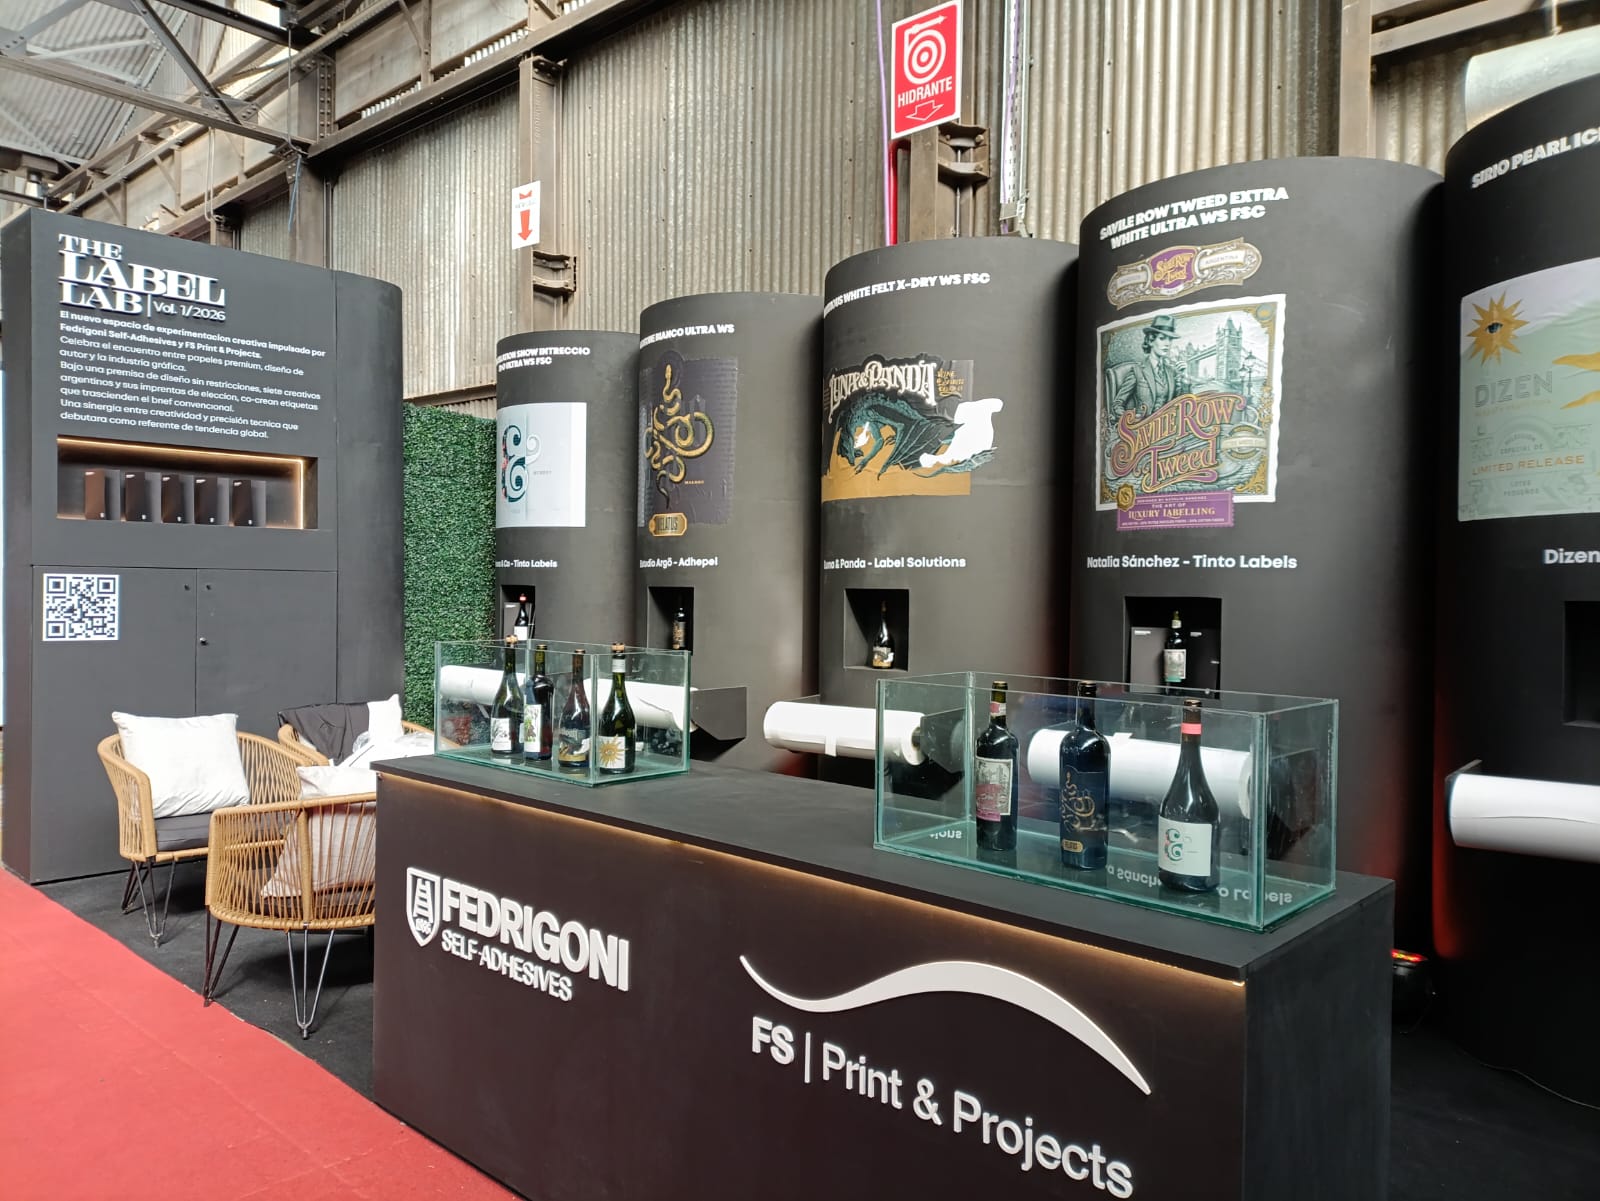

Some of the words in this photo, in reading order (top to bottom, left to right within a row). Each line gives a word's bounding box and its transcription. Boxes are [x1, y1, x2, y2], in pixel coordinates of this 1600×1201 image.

[897, 75, 952, 108] HIDRANTE
[1471, 159, 1510, 188] SIRIO
[1511, 136, 1572, 171] PEARL
[1573, 126, 1600, 149] IC
[1100, 215, 1134, 240] SAVILE
[1135, 204, 1170, 226] ROW
[1169, 194, 1227, 215] TWEED
[1229, 187, 1289, 204] EXTRA
[1110, 225, 1150, 249] WHITE
[1150, 214, 1200, 237] ULTRA
[1200, 208, 1229, 225] WS
[1230, 205, 1266, 221] FSC
[58, 233, 123, 260] THE
[58, 250, 226, 306] LABEL
[843, 285, 871, 303] WHITE
[871, 280, 896, 295] FELT
[896, 276, 938, 290] X-DRY
[939, 274, 961, 286] WS
[963, 272, 991, 284] FSC
[58, 281, 143, 314] LAB
[153, 301, 178, 314] Vol.
[180, 304, 226, 321] 1/2026
[60, 310, 69, 318] El
[70, 313, 101, 324] nuevo
[103, 318, 141, 329] espacio
[142, 323, 155, 332] de
[232, 337, 267, 348] creativa
[268, 341, 310, 355] impulsado
[311, 349, 326, 357] por
[60, 323, 107, 336] Fedrigoni
[108, 330, 177, 346] Self-Adhesives
[177, 341, 184, 349] y
[185, 341, 196, 349] FS
[197, 342, 217, 353] Print
[219, 346, 225, 354] &
[226, 347, 262, 359] Projects.
[685, 324, 716, 335] ULTRA
[716, 323, 735, 333] WS
[59, 335, 100, 348] Celebra
[102, 342, 111, 350] el
[112, 344, 161, 357] encuentro
[162, 350, 186, 360] entre
[187, 354, 223, 365] papeles
[224, 359, 263, 371] premium,
[264, 363, 291, 374] diseño
[293, 367, 304, 376] de
[59, 349, 89, 358] autor
[89, 352, 96, 361] y
[97, 352, 106, 361] la
[108, 354, 150, 367] industria
[151, 361, 187, 372] gráfica.
[523, 357, 535, 366] WS
[536, 356, 552, 366] FSC
[60, 360, 83, 372] Bajo
[85, 365, 104, 374] una
[106, 367, 145, 378] premisa
[146, 371, 159, 380] de
[160, 373, 190, 385] diseño
[192, 377, 205, 386] sin
[205, 379, 262, 393] restricciones,
[262, 386, 282, 395] siete
[284, 389, 321, 400] creativos
[60, 374, 114, 387] argentinos
[114, 381, 121, 389] y
[122, 382, 139, 390] sus
[140, 382, 186, 395] imprentas
[187, 388, 199, 397] de
[240, 395, 279, 406] co-crean
[280, 400, 318, 411] etiquetas
[1474, 371, 1553, 408] DIZEN
[60, 387, 80, 396] que
[81, 389, 140, 402] trascienden
[141, 395, 150, 403] el
[174, 400, 235, 413] convencional.
[60, 398, 81, 408] Una
[82, 401, 122, 413] sinergia
[123, 406, 148, 415] entre
[149, 408, 202, 420] creatividad
[202, 414, 210, 422] y
[209, 414, 249, 425] precisión
[282, 422, 299, 431] que
[109, 417, 137, 427] como
[138, 419, 180, 430] referente
[181, 422, 194, 431] de
[194, 424, 239, 436] tendencia
[240, 429, 269, 438] global.
[1472, 462, 1514, 476] LIMITED
[1518, 454, 1585, 469] RELEASE
[1128, 509, 1160, 520] LUXURY
[1163, 507, 1216, 519] LABELLING
[513, 559, 530, 568] Tinto
[530, 559, 558, 568] Labels
[678, 556, 718, 568] Adhepel
[840, 557, 866, 568] Panda
[874, 557, 905, 568] Label
[906, 556, 966, 568] Solutions
[1086, 555, 1120, 568] Natalia
[1121, 554, 1180, 568] Sánchez
[1192, 554, 1236, 568] Tinto
[1240, 554, 1298, 569] Labels
[442, 877, 629, 992] FEDRIGONI
[441, 928, 573, 1002] SELF-ADHESIVES
[751, 1015, 795, 1065] FS
[822, 1041, 903, 1110] Print
[912, 1078, 943, 1126] &
[953, 1089, 1134, 1200] Projects
